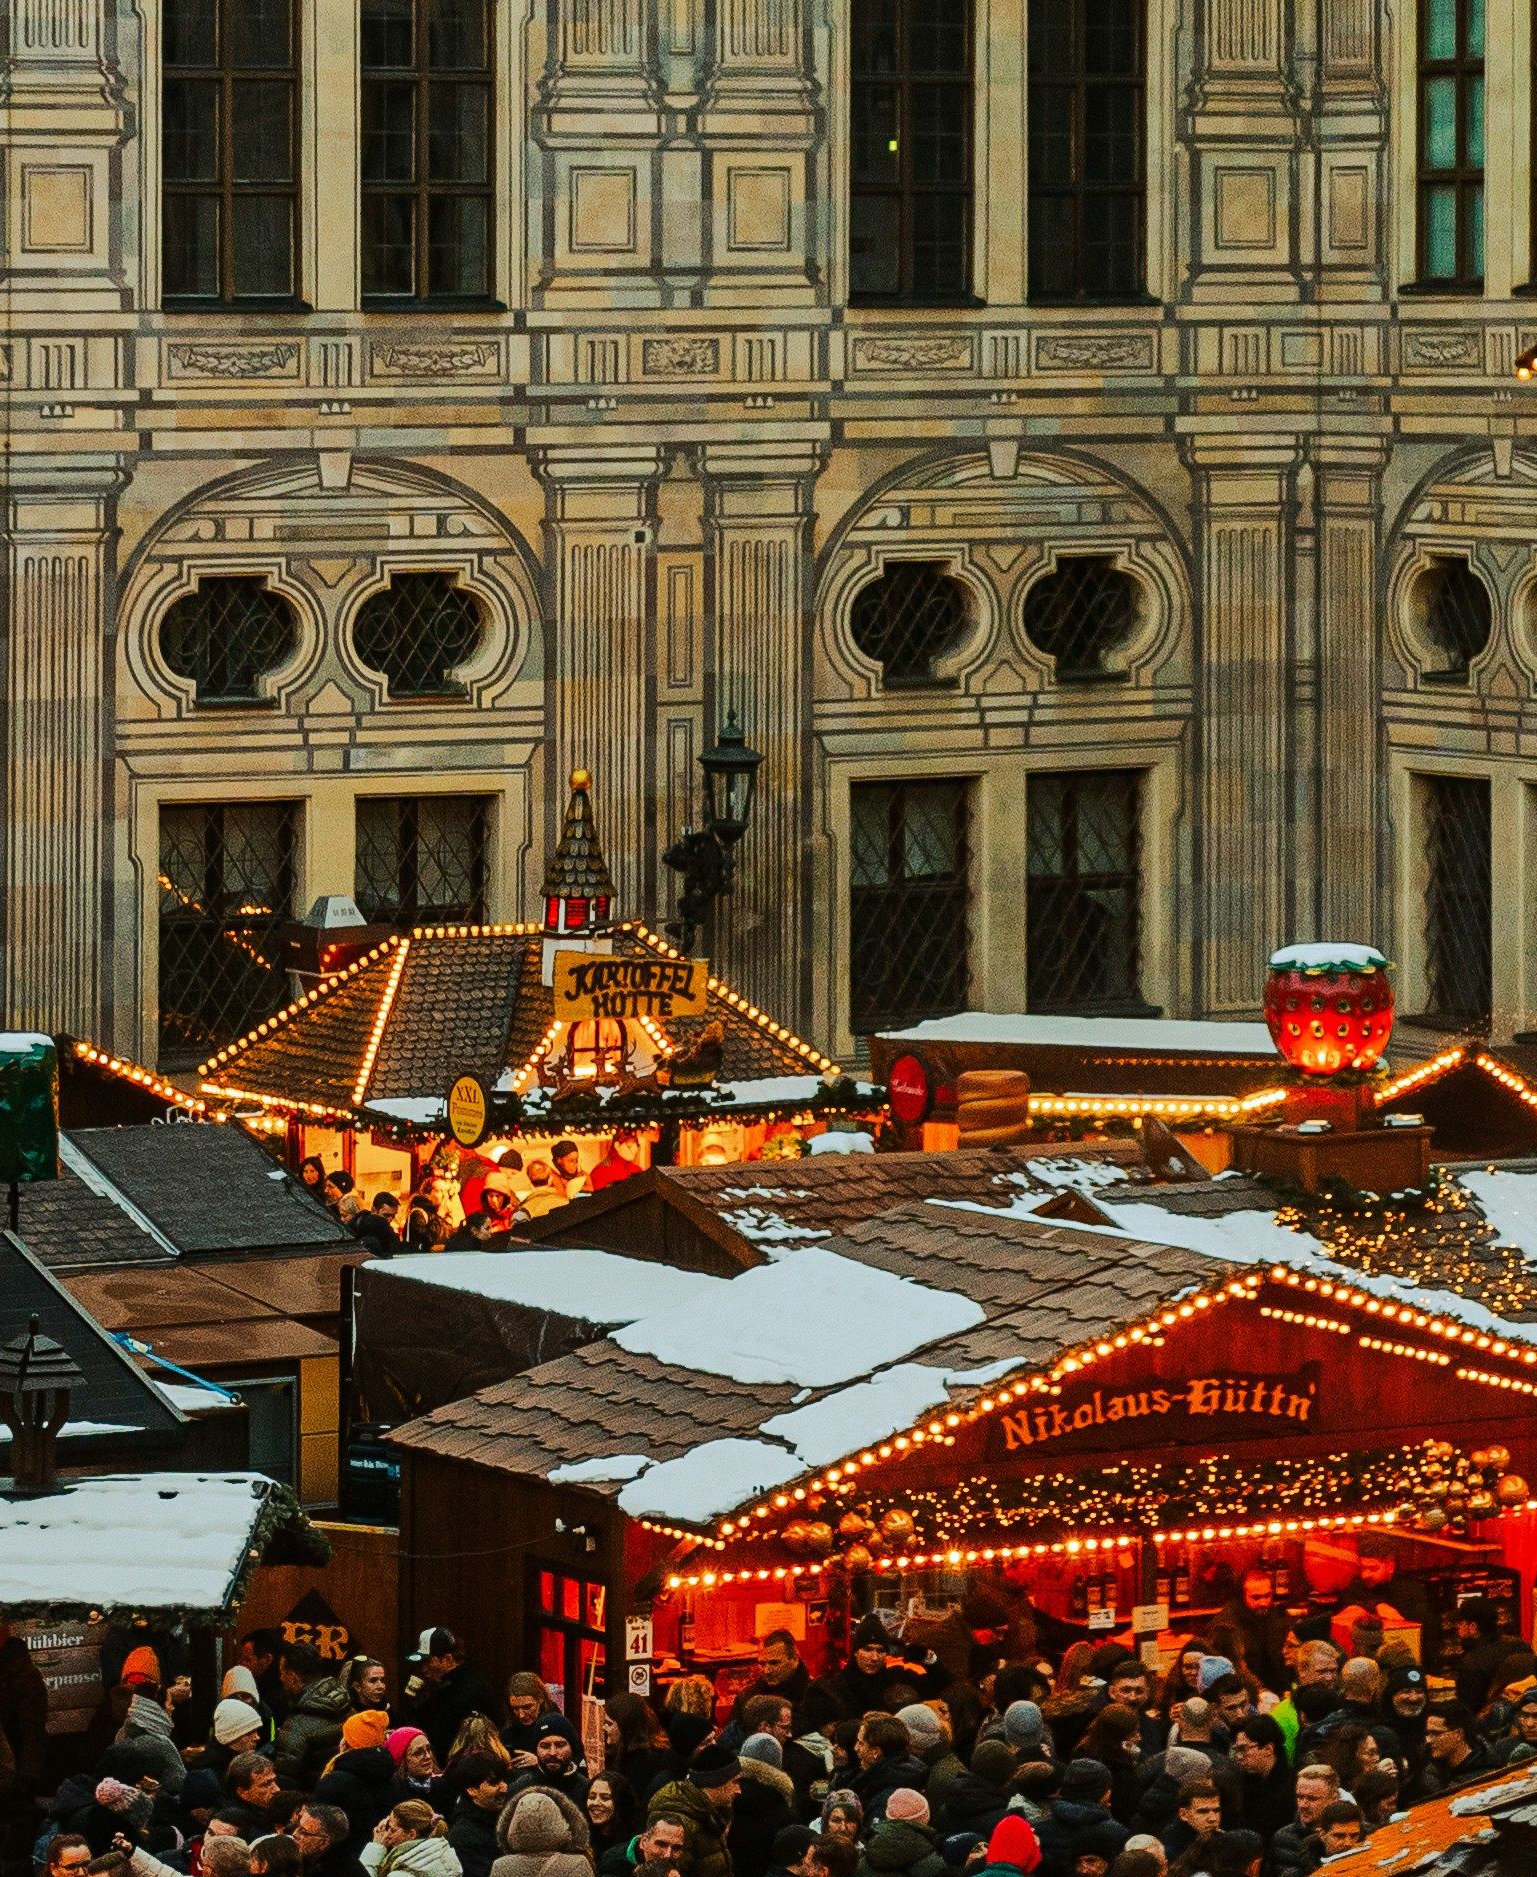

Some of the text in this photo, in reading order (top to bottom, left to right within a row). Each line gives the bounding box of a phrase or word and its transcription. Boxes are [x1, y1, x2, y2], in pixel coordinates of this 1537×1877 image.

[564, 960, 696, 1001] KARTOFFEL
[455, 1086, 480, 1105] XXL
[630, 1633, 648, 1654] 41
